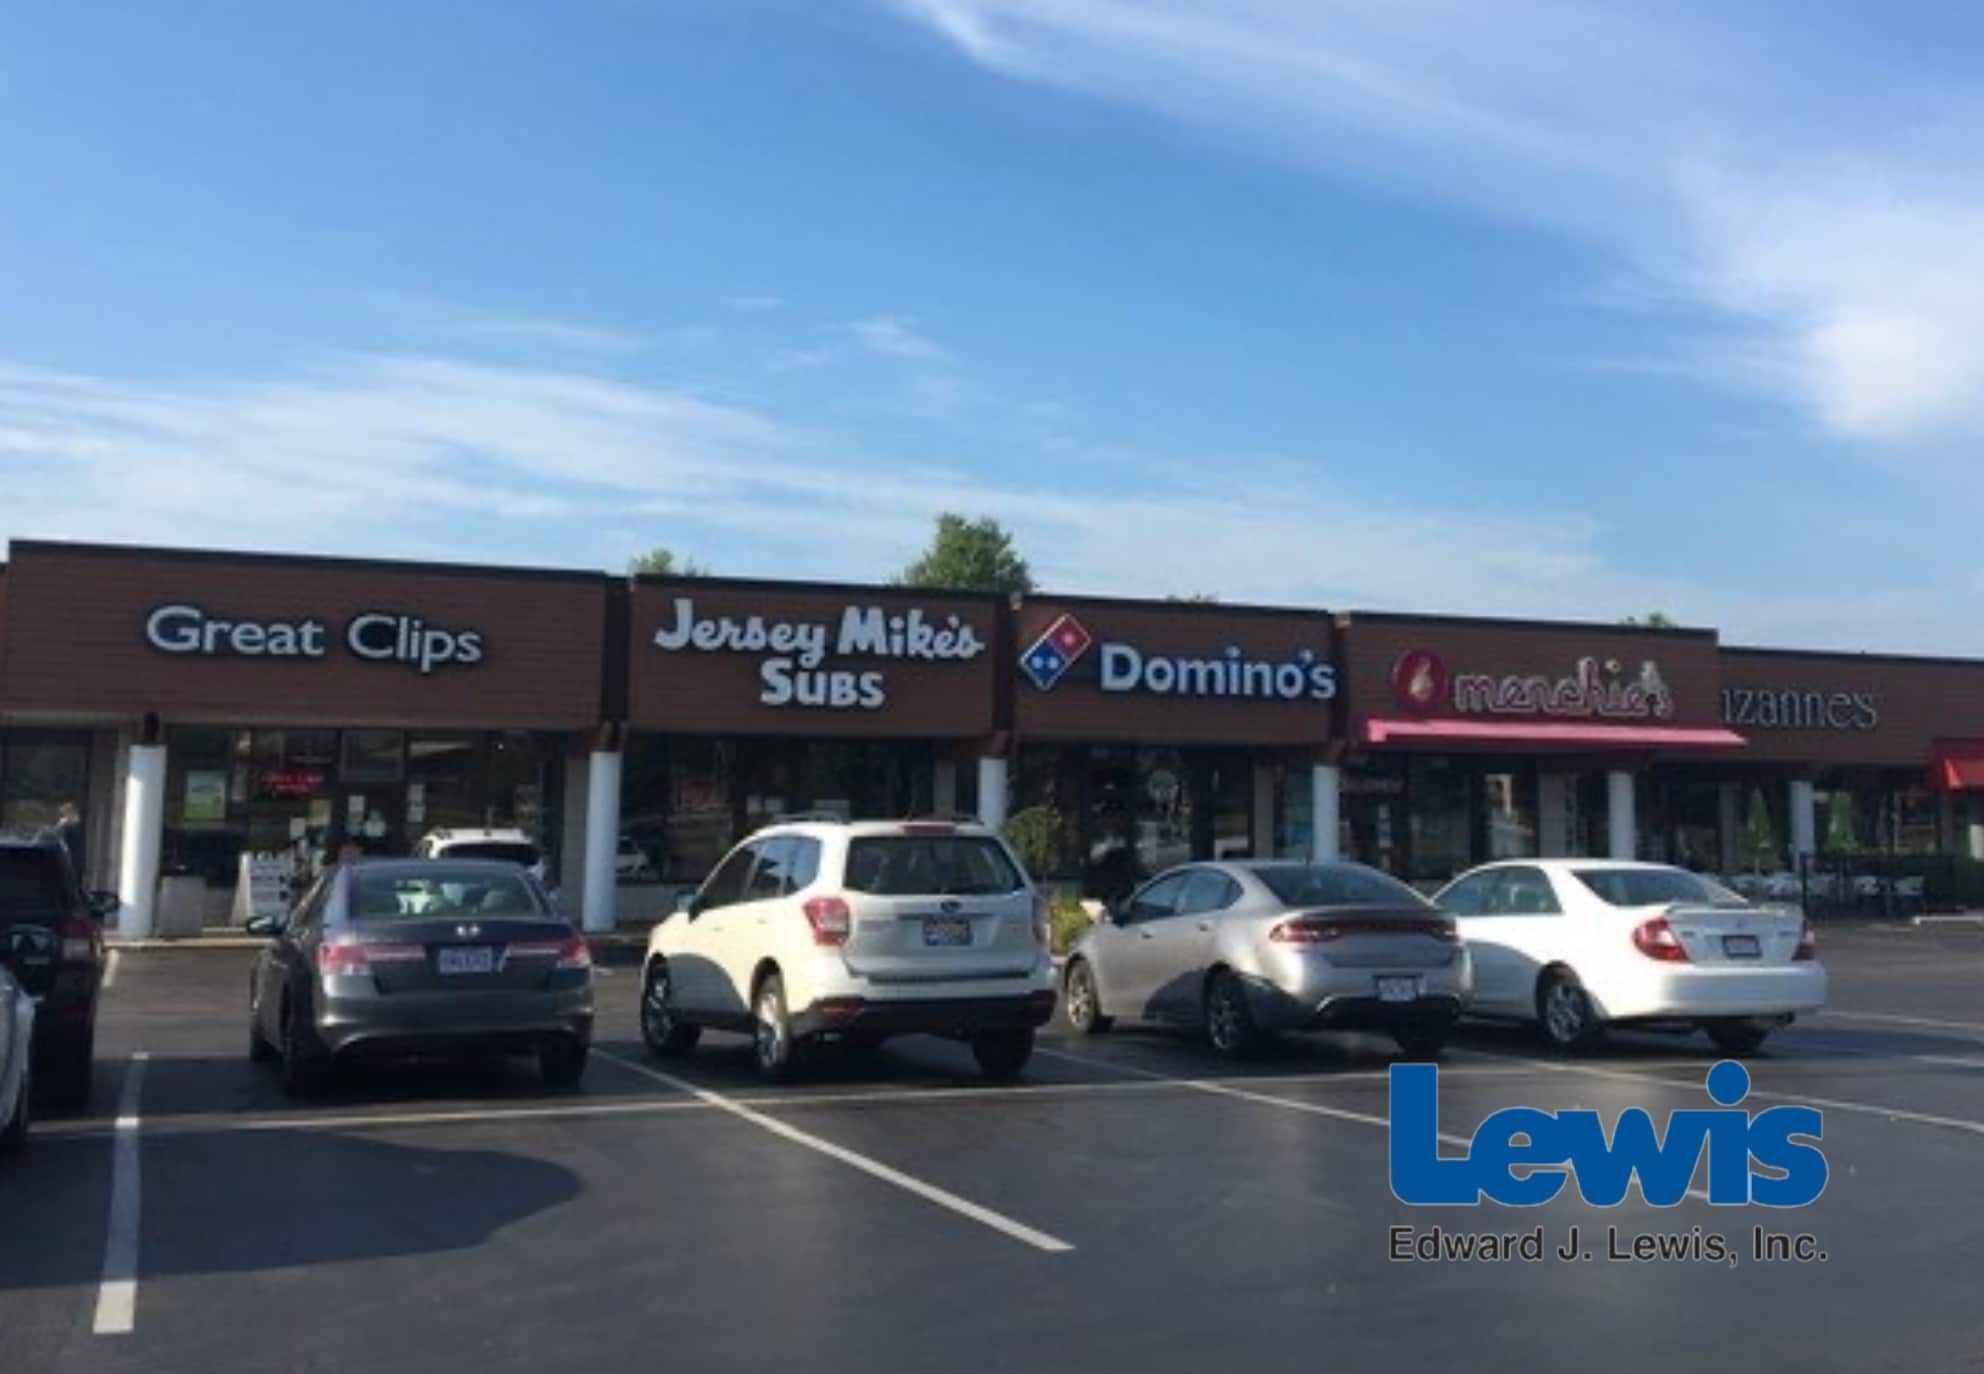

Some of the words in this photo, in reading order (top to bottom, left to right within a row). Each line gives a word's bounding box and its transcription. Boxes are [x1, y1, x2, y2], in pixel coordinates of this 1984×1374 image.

[145, 604, 325, 656] Great
[347, 613, 483, 673] Clips
[653, 597, 826, 669] Jersey
[838, 604, 986, 659] Mike's
[1099, 642, 1338, 699] Domino's
